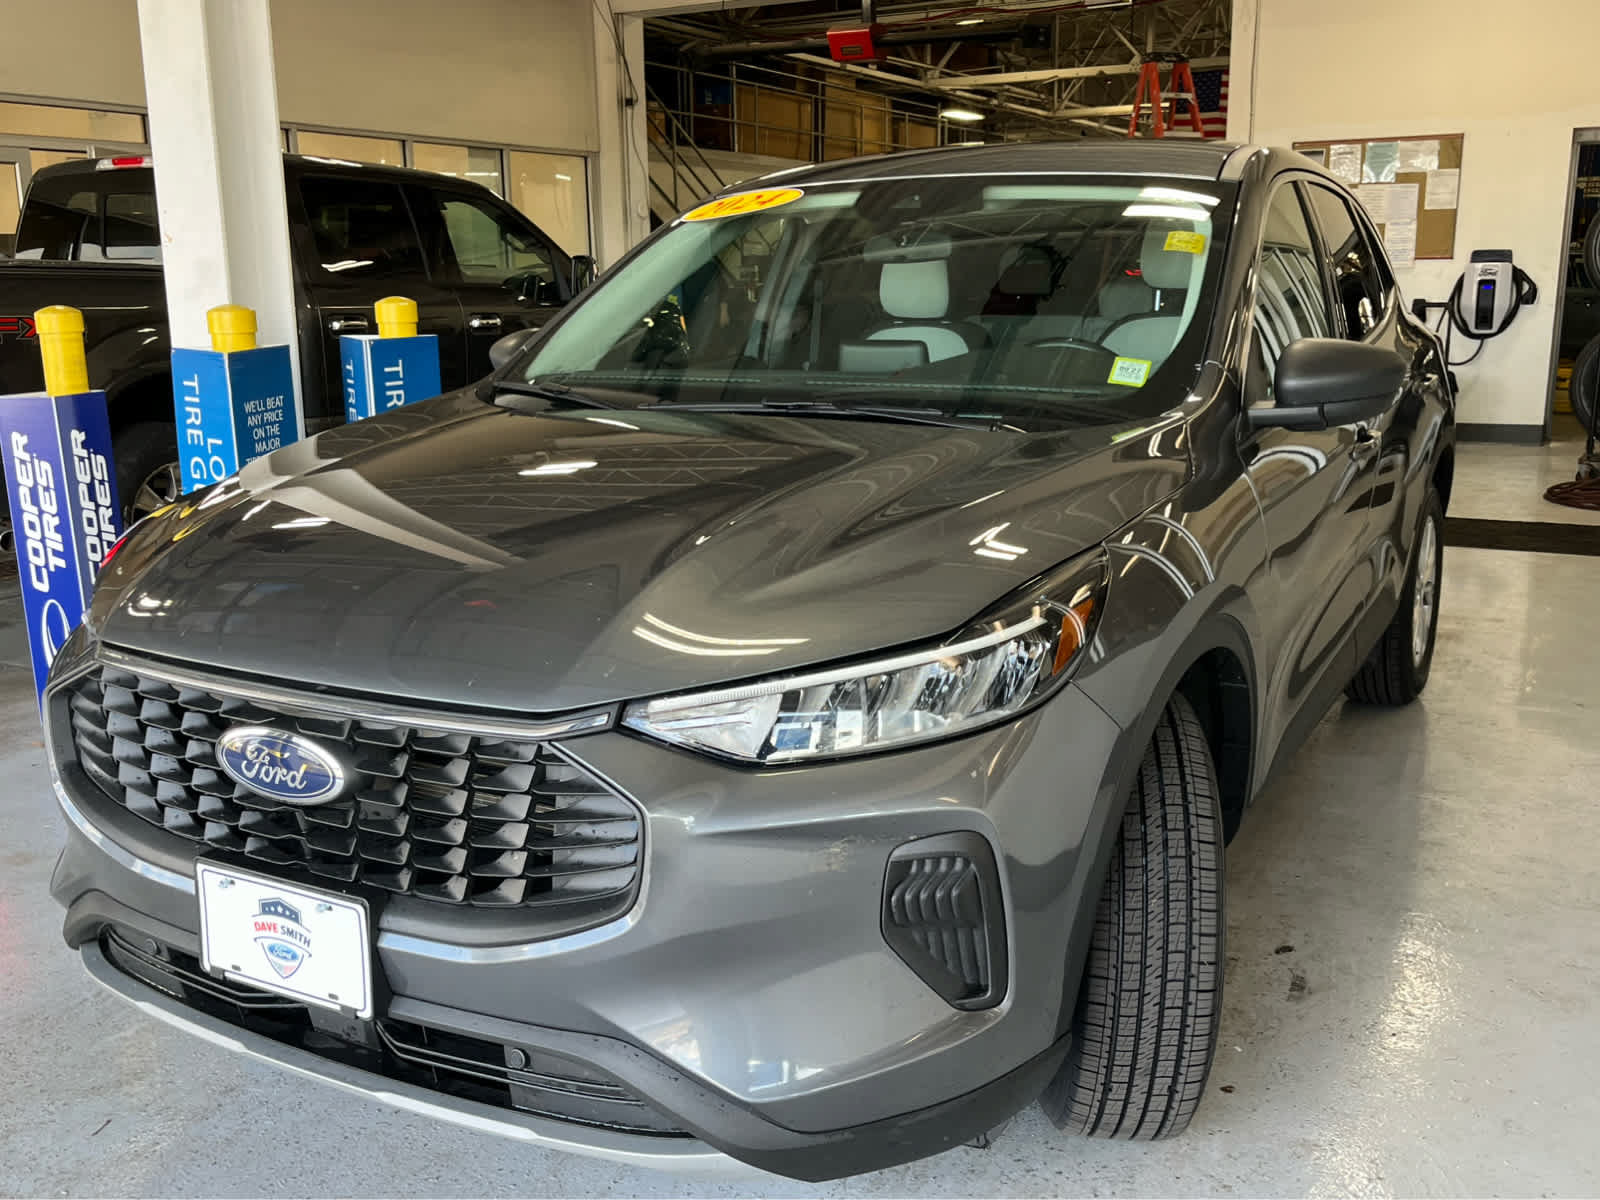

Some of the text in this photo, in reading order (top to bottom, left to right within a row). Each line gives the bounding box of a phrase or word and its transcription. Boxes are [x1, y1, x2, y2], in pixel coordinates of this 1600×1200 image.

[244, 395, 284, 414] WE'LL BEAT
[345, 359, 358, 422] TIRE
[384, 359, 405, 408] TIR
[182, 373, 204, 447] TIRE
[247, 409, 284, 427] ANY PRICE
[253, 424, 281, 440] ON THE
[207, 437, 226, 482] LO
[255, 437, 281, 454] MAJOR
[11, 431, 50, 592] COOPER
[34, 457, 67, 572] TIRES
[241, 743, 308, 789] Ford
[254, 920, 311, 948] DAVE SMITH
